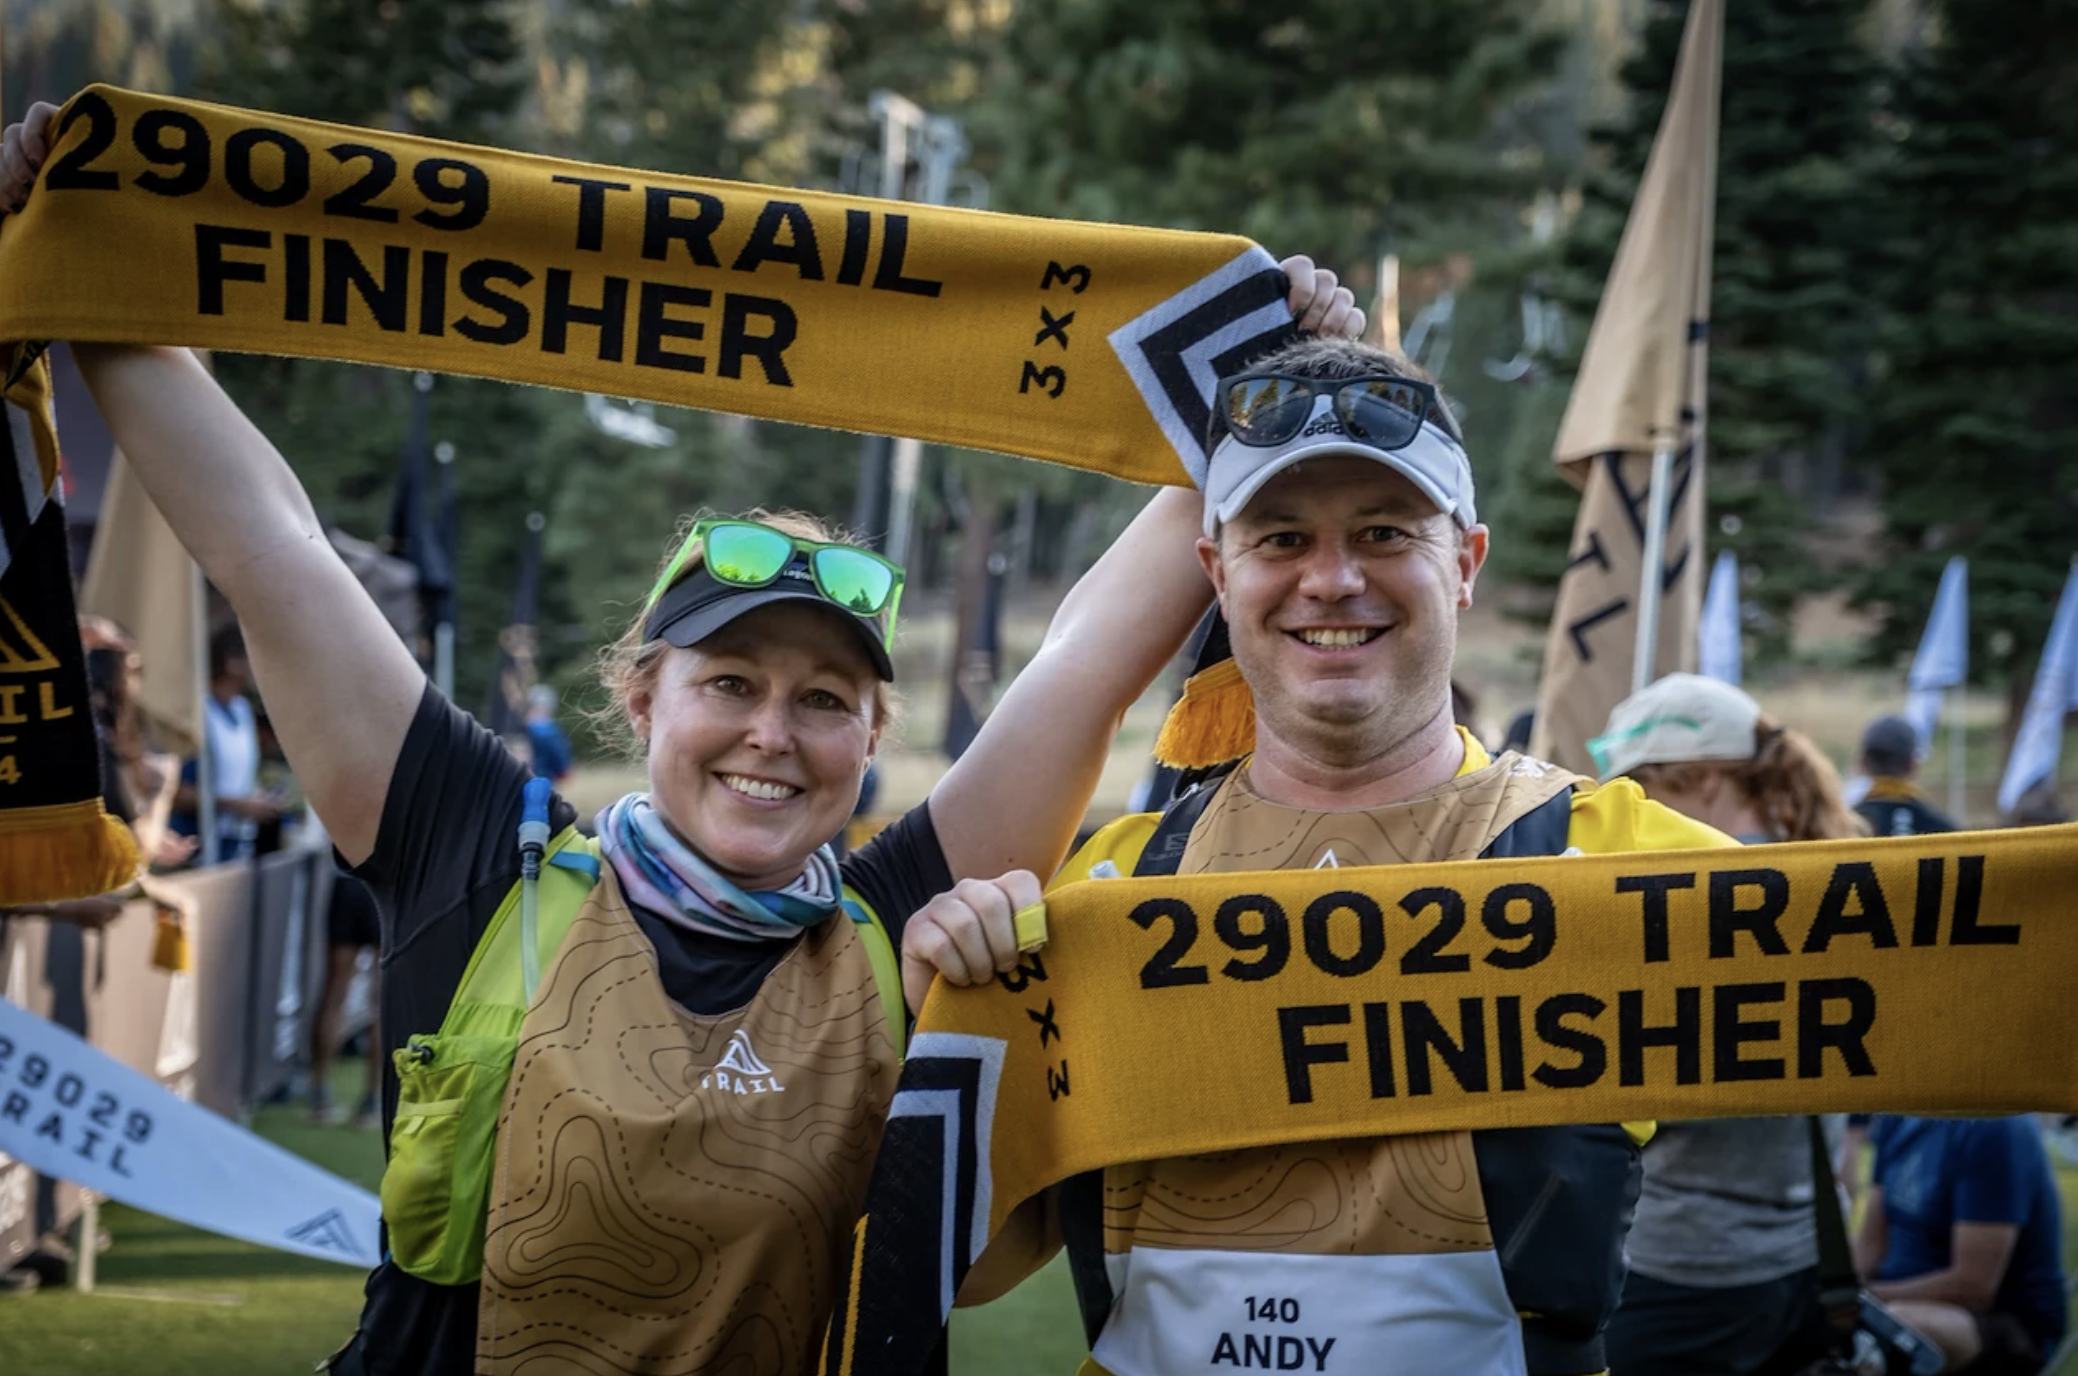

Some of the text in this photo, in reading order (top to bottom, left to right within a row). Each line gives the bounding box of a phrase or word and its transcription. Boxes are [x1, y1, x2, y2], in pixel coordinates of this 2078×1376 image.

[45, 93, 941, 298] 29029 TRAIL
[195, 223, 798, 387] FINISHER
[1128, 855, 2021, 989] 29029 TRAIL
[1276, 977, 1877, 1104] FINISHER
[1211, 1332, 1337, 1372] ANDY
[1244, 1296, 1300, 1324] 140
